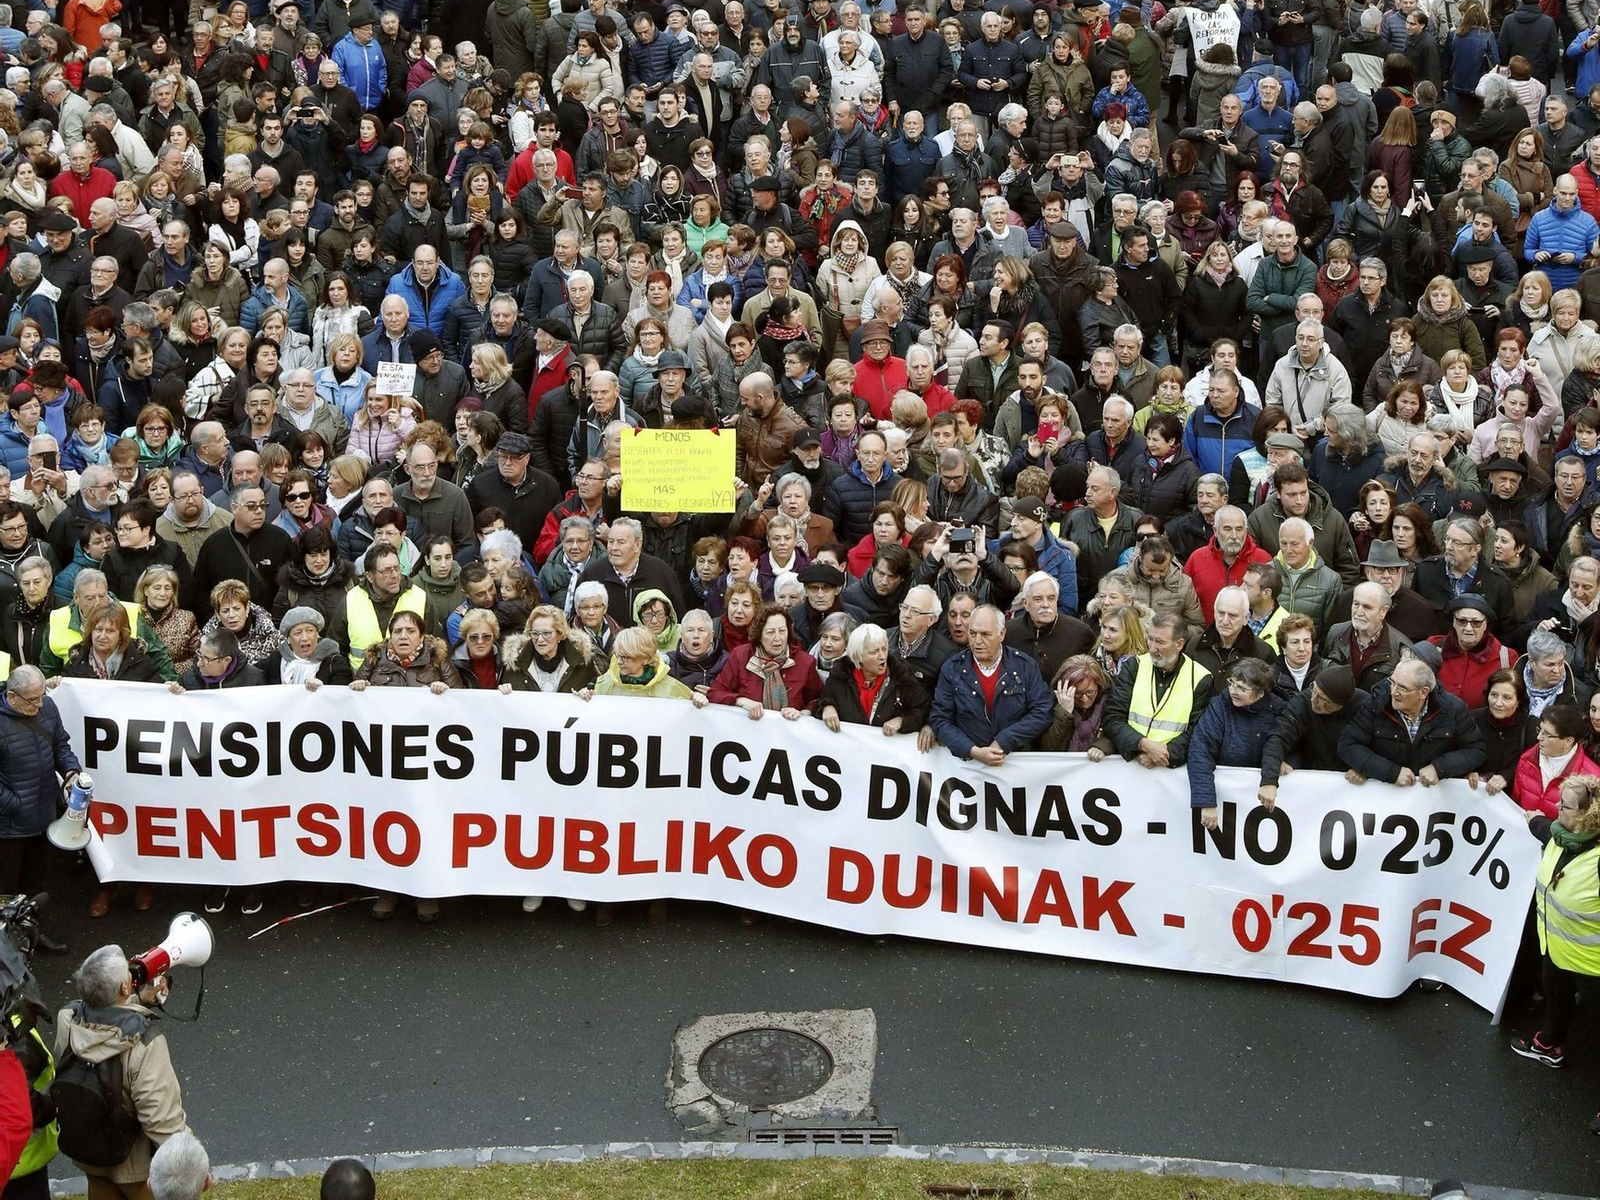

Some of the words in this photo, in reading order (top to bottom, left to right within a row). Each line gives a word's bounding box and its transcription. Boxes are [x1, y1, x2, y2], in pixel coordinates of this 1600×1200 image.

[1192, 12, 1228, 23] KONTRA
[1208, 21, 1222, 29] LAS
[1195, 28, 1235, 39] REFORMAS
[382, 363, 404, 372] ESTA
[655, 432, 691, 442] MENOS
[624, 446, 663, 456] RESCATES
[666, 447, 674, 455] A
[676, 447, 686, 455] LA
[625, 497, 670, 508] PENSIONES
[678, 498, 712, 508] DIGNAS
[84, 716, 475, 781] PENSIONES
[502, 717, 842, 812] PÚBLICAS
[867, 764, 1123, 846] DIGNAS
[1192, 802, 1293, 866] NO
[1319, 810, 1511, 891] 0'25%
[89, 800, 421, 868] PENTSIO
[452, 813, 798, 889] PUBLIKO
[826, 847, 1136, 936] DUINAK
[1232, 894, 1381, 966] 0'25
[1409, 898, 1492, 975] EZ
